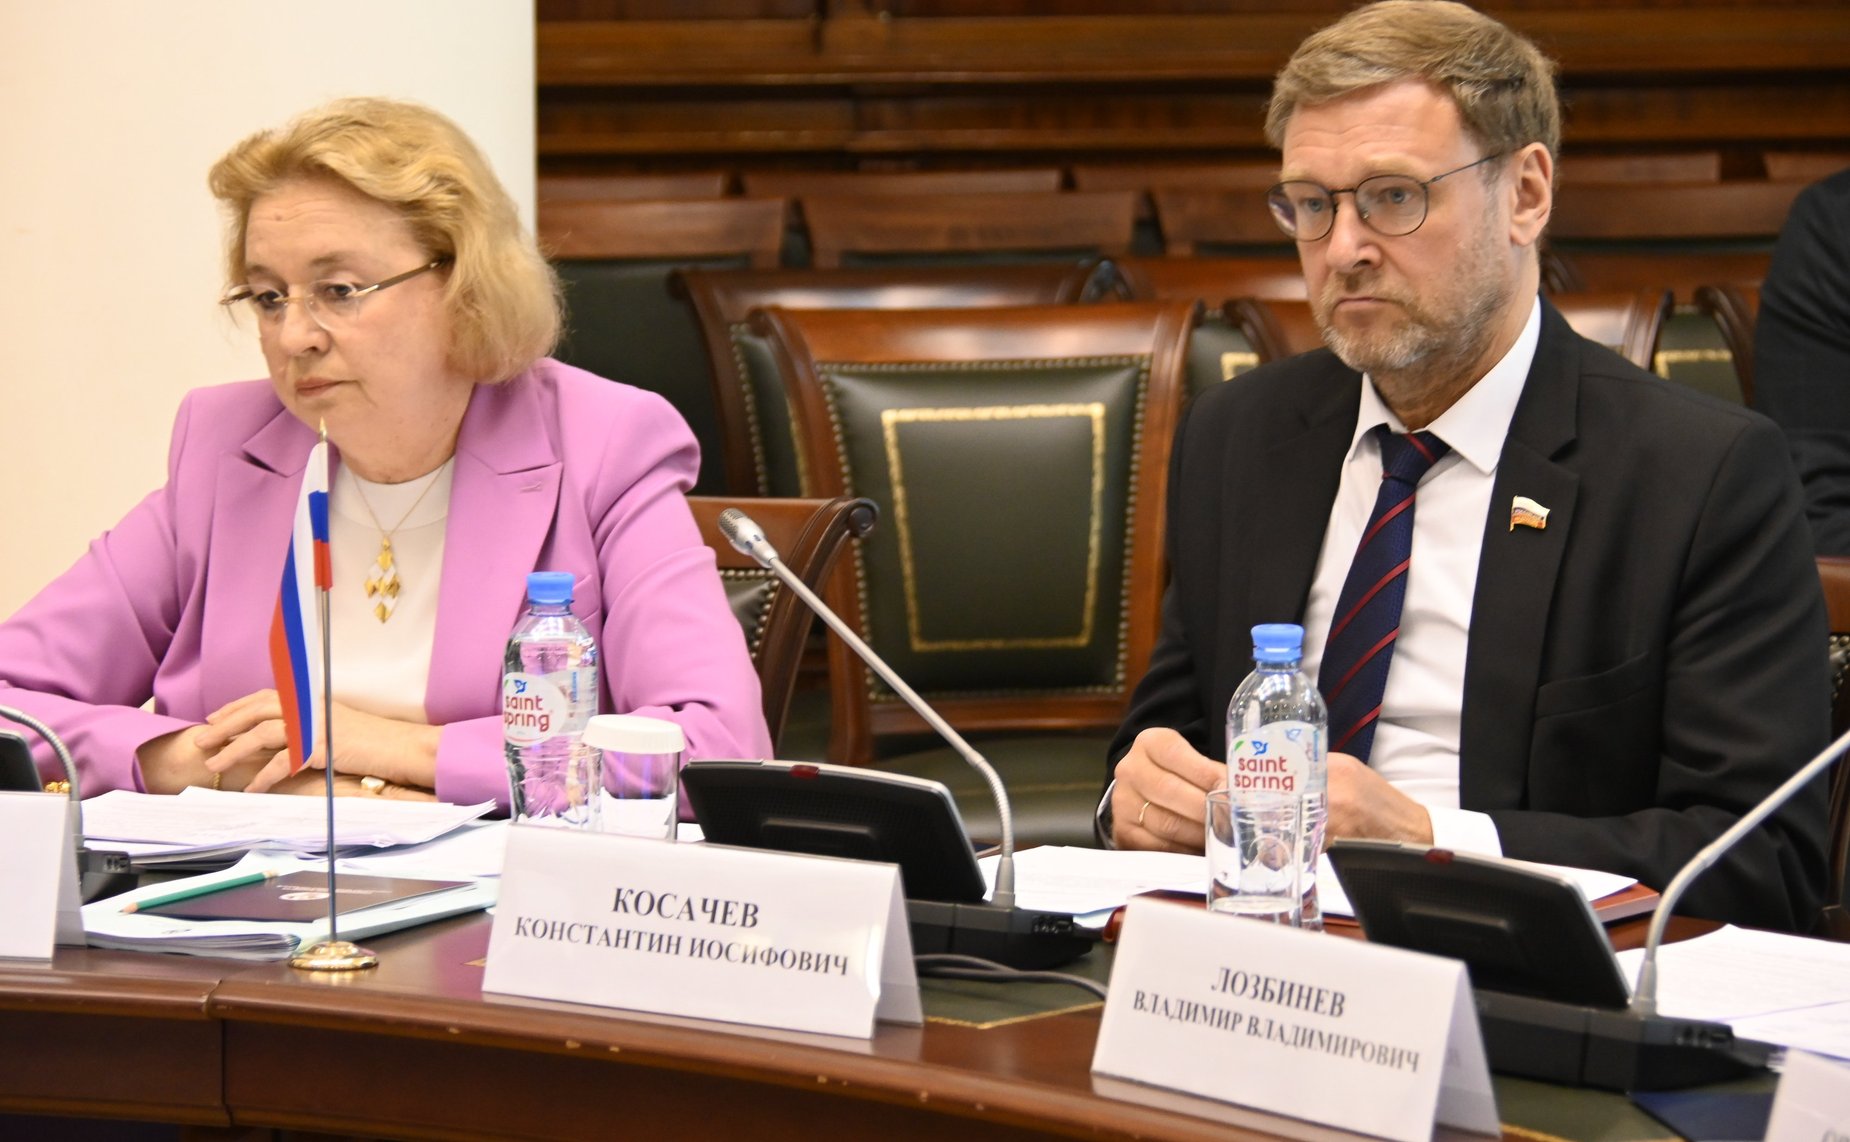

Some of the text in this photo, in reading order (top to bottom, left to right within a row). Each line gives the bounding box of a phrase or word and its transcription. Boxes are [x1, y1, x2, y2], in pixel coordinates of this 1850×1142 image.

[1234, 773, 1294, 791] spring
[1238, 756, 1287, 773] saint
[611, 887, 761, 929] КОСАЧЕВ
[514, 917, 850, 976] КОНСТАНТИН ИОСИФОВИЧ
[1211, 967, 1347, 1018] ЛОЗБИНЕВ
[1133, 990, 1421, 1073] ВЛАДИМИР ВЛАДИМИРОВИЧ
